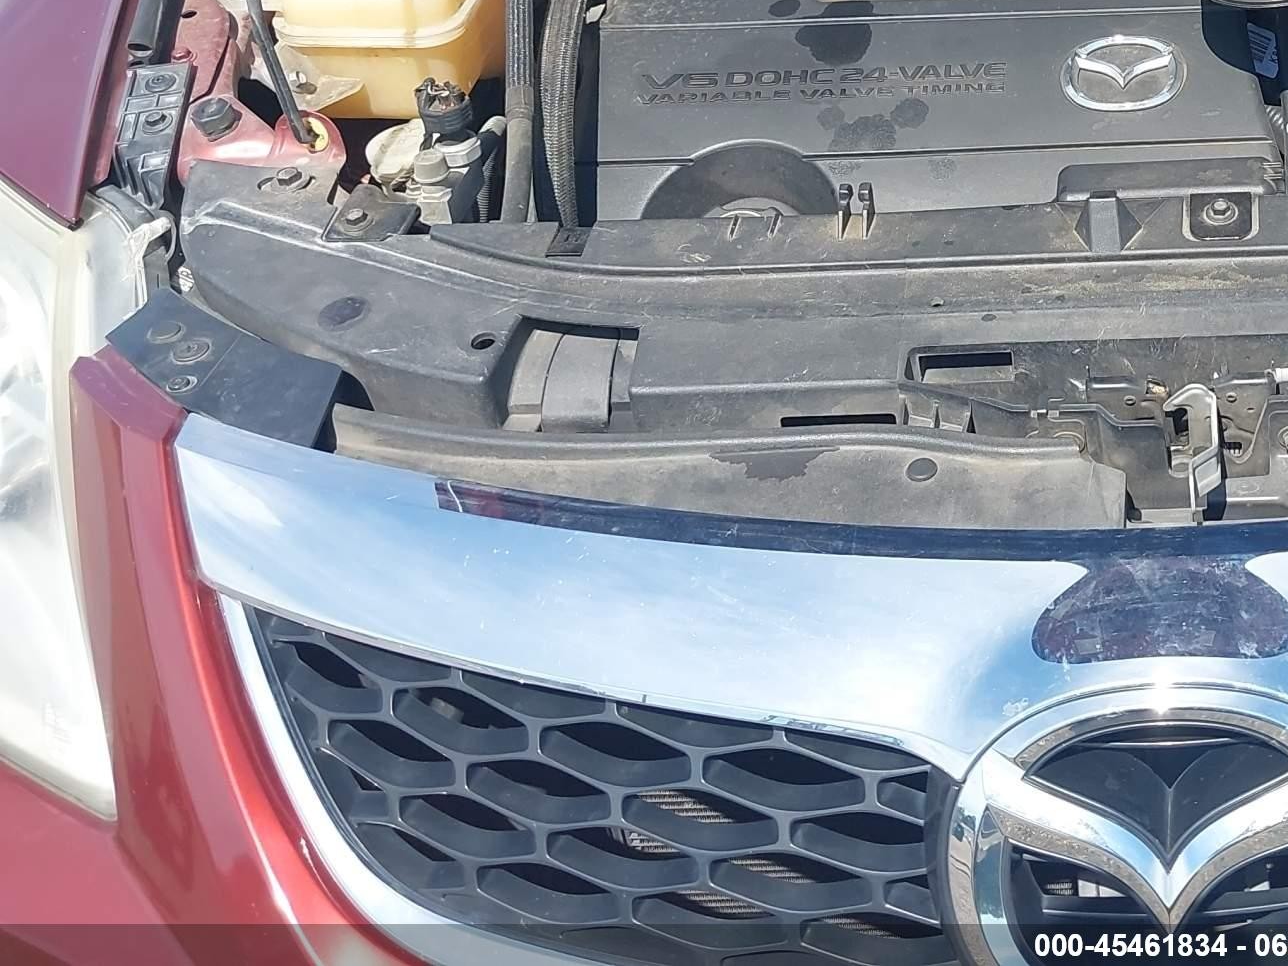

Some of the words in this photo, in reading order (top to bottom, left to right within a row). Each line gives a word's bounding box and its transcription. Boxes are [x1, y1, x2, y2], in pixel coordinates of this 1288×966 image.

[642, 73, 719, 90] V6
[724, 68, 836, 88] DOHC
[838, 62, 1007, 84] 24-VALVE
[636, 89, 792, 105] VARIABLE
[799, 86, 894, 100] VALVE
[899, 82, 1006, 97] TIMING
